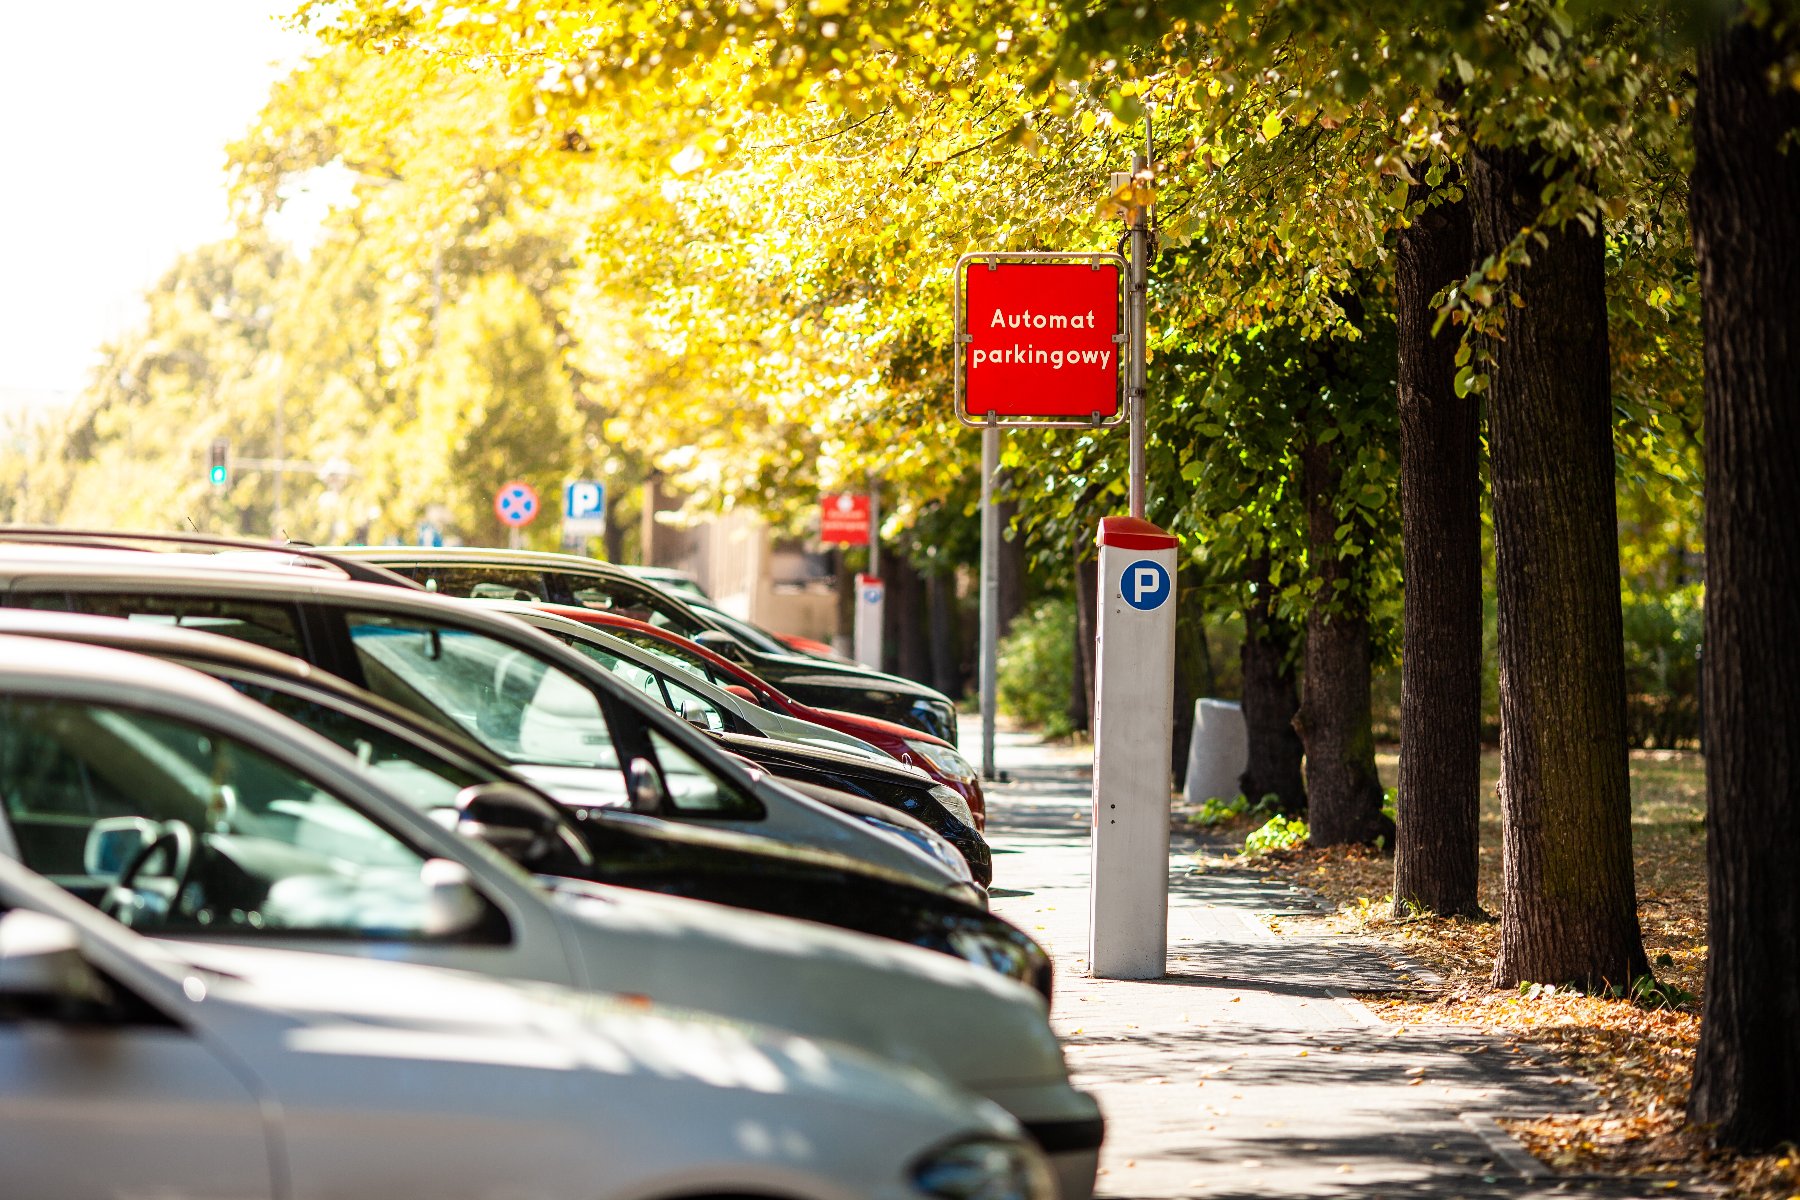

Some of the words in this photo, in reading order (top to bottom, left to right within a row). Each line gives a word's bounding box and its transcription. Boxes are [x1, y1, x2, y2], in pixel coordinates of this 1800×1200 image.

[990, 308, 1095, 329] Automat
[972, 344, 1111, 370] parkingowy
[573, 483, 599, 517] P
[1134, 567, 1160, 603] P
